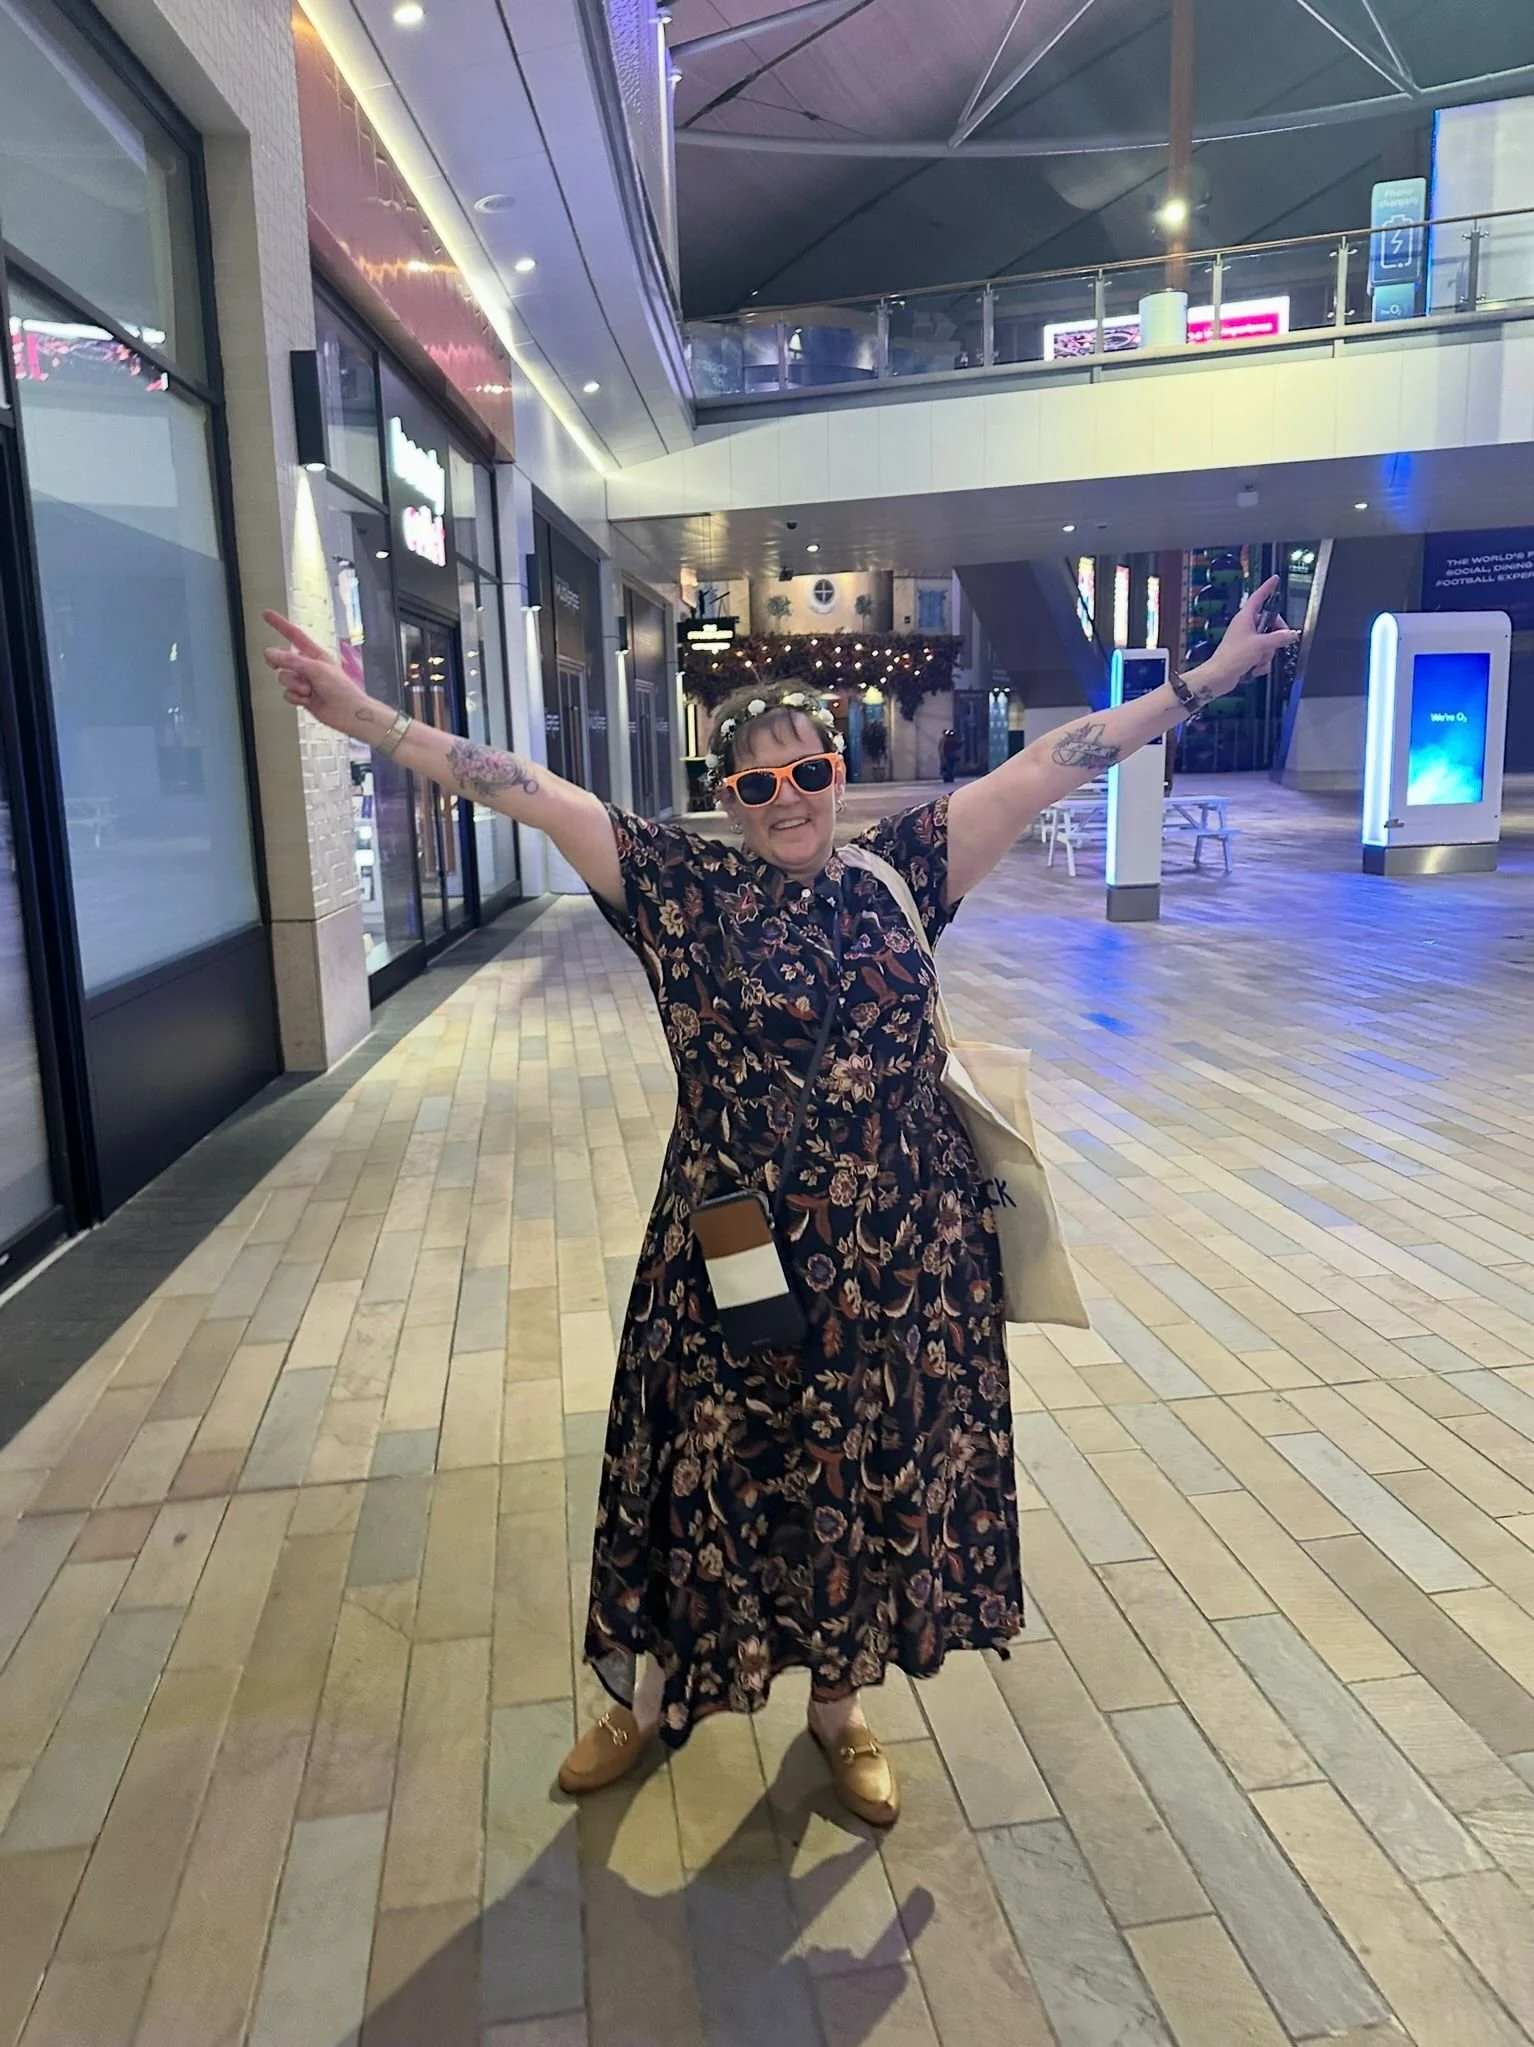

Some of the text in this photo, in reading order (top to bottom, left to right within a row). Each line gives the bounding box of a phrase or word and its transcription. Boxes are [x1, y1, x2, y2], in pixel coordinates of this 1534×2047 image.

[1447, 558, 1469, 566] THE
[1471, 552, 1525, 564] WORLD'S
[1493, 561, 1533, 572] DINING
[1435, 576, 1495, 587] FOOTBALL
[1430, 712, 1455, 722] We're
